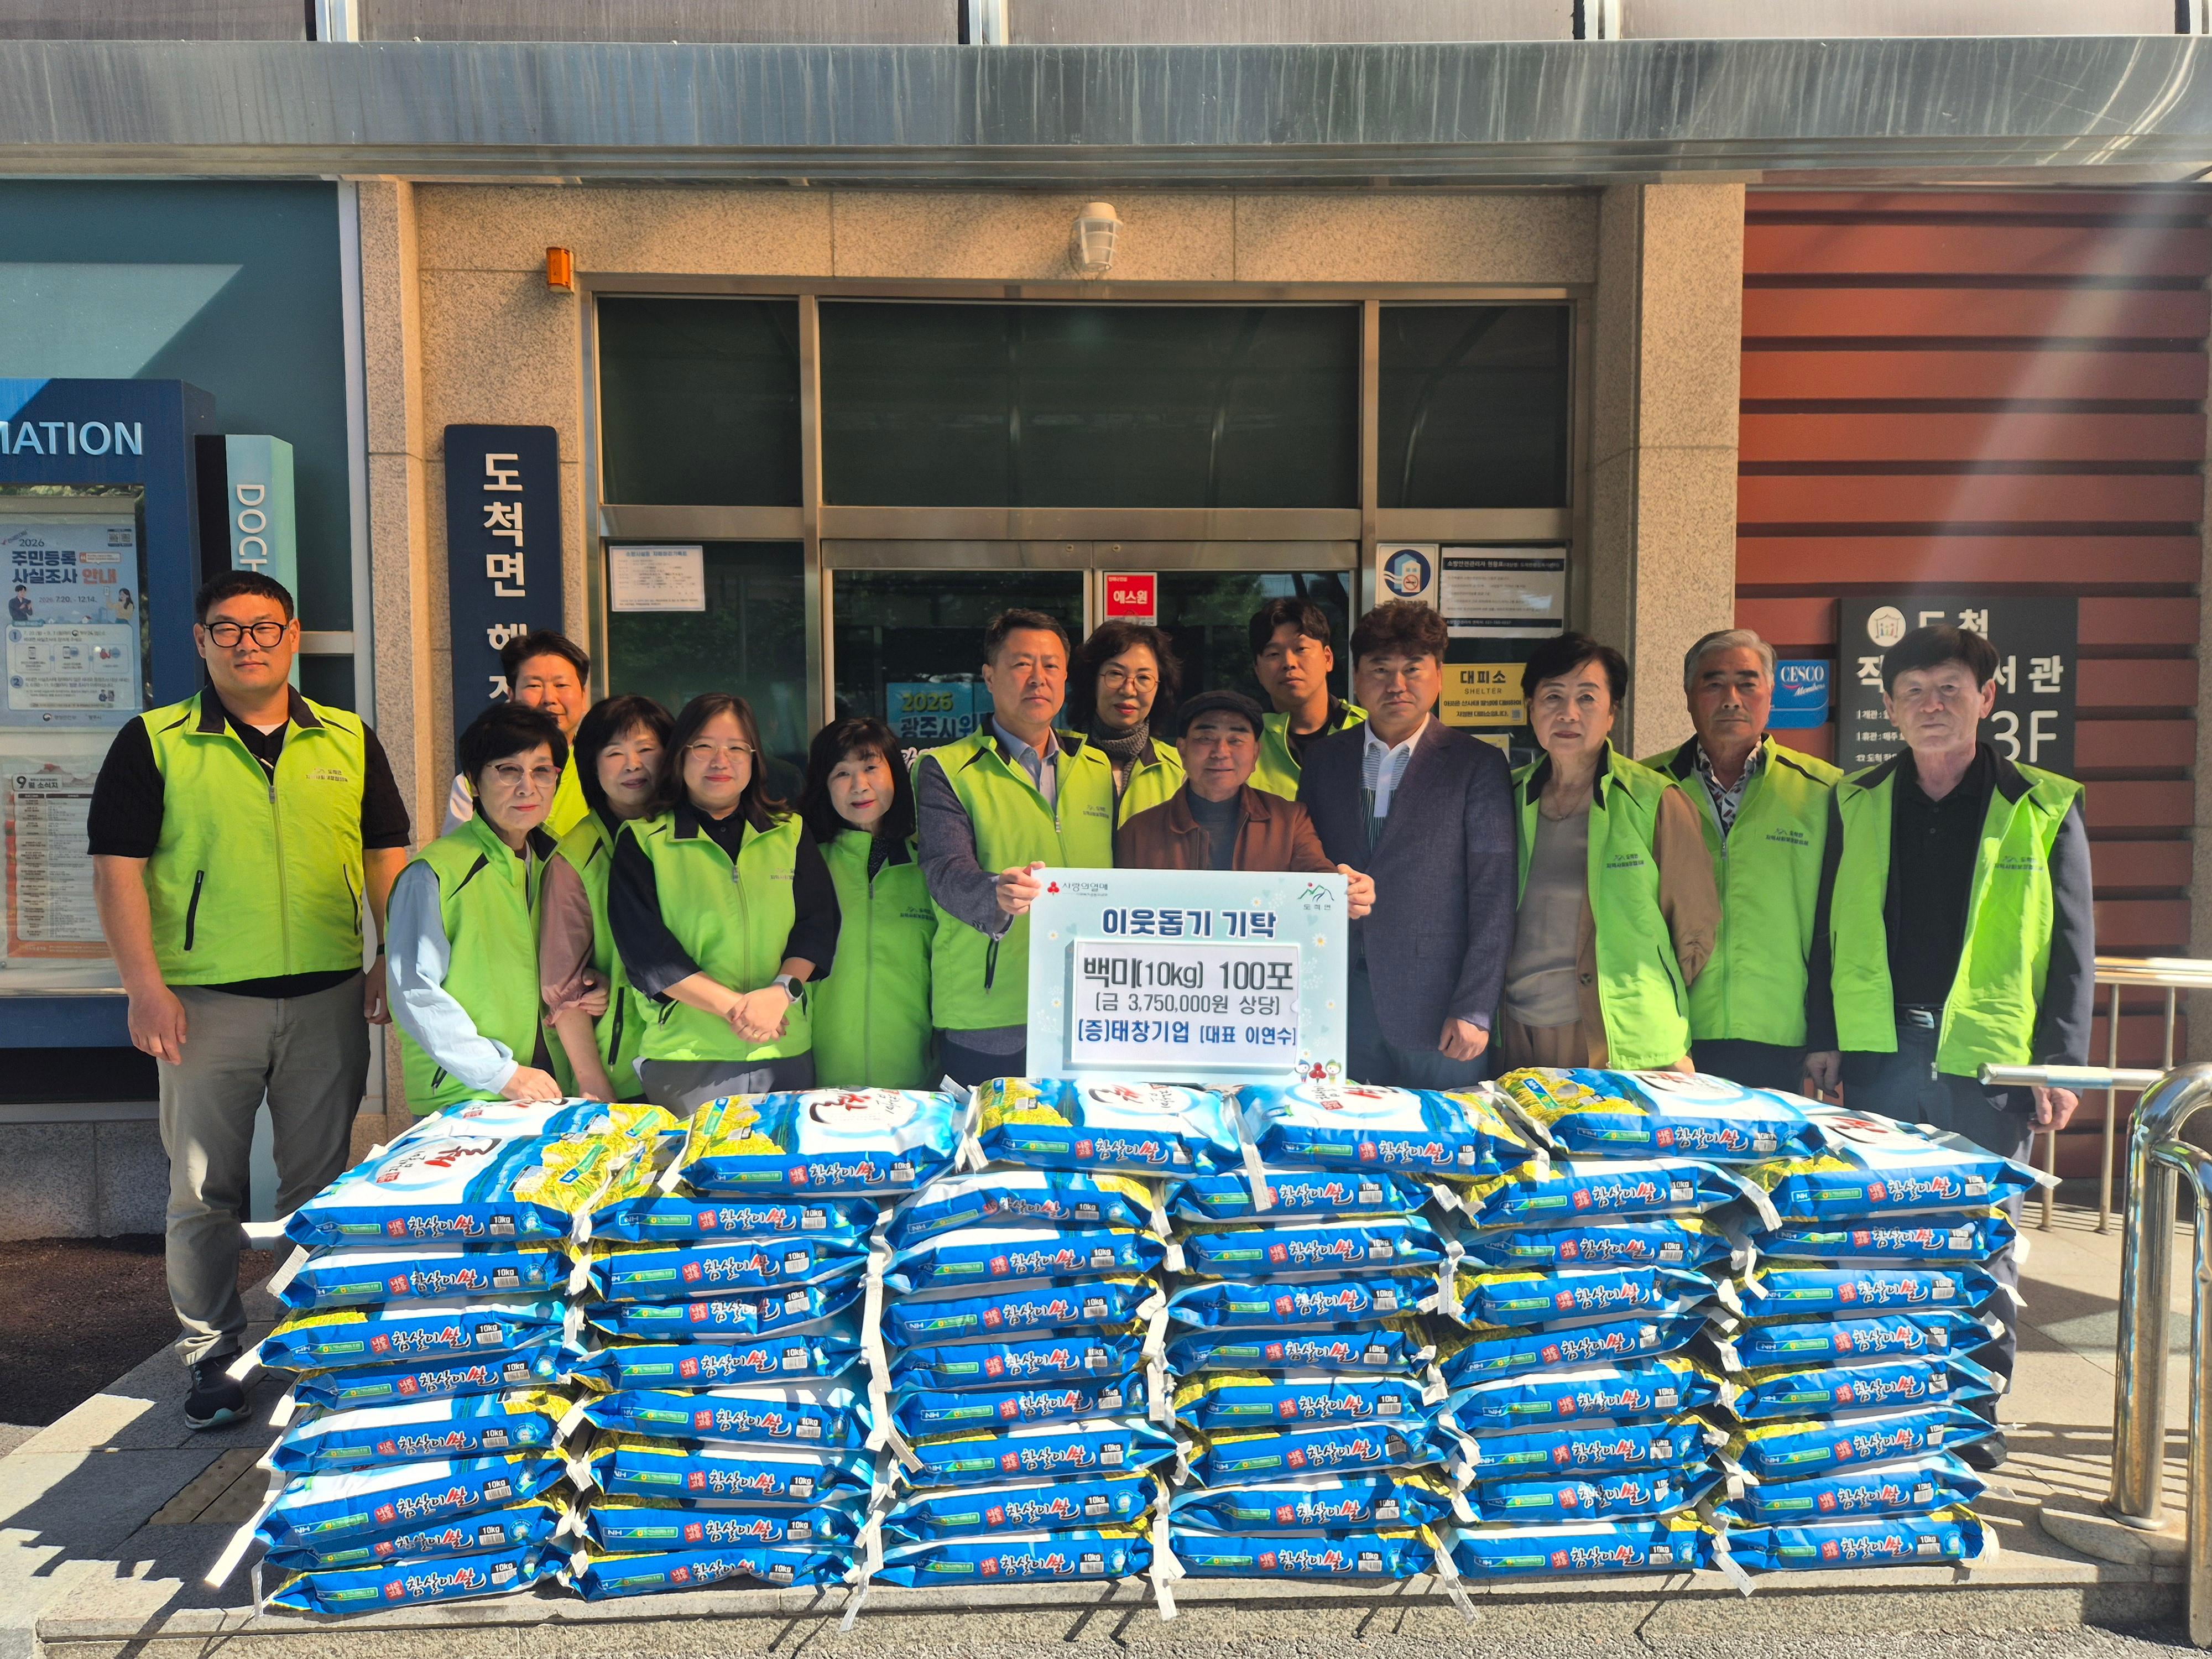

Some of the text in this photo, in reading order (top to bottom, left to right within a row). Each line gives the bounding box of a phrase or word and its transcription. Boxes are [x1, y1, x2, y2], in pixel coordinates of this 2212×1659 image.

[0, 421, 142, 455] ATION
[484, 453, 525, 597] 도척면
[12, 551, 76, 566] 주민등록
[12, 568, 117, 584] 사실조사 안내
[1113, 590, 1147, 604] 에스원
[1460, 670, 1506, 684] 대피소
[1781, 665, 1824, 682] CESCO
[902, 692, 953, 711] 2026
[1991, 710, 2058, 763] 3F
[1062, 883, 1108, 892] 사랑의열매
[1103, 909, 1276, 938] 이웃돕기 기탁
[1219, 961, 1293, 990] 100포
[1129, 993, 1228, 1014] 3,750,000원
